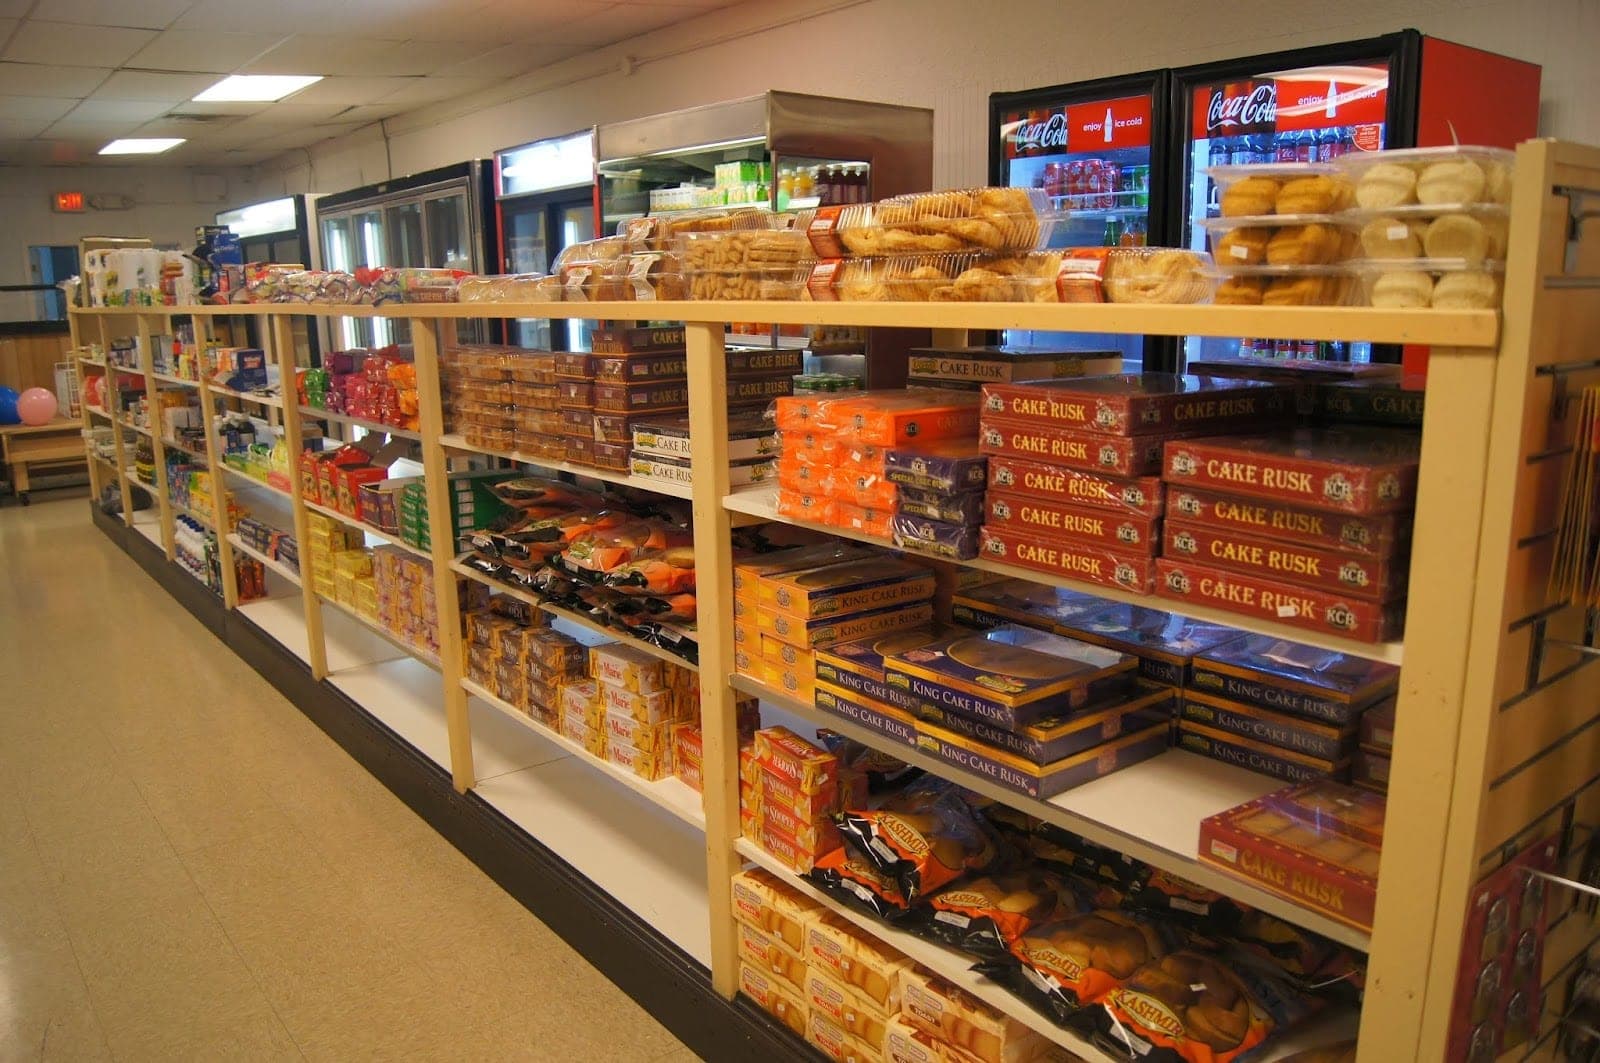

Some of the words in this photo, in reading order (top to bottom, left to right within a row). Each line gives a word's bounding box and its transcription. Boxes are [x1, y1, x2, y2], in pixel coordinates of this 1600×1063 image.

[1298, 95, 1323, 106] enjoy
[1083, 123, 1103, 133] enjoy
[1115, 120, 1125, 128] ice
[1127, 117, 1142, 126] cold
[652, 332, 679, 345] CAKE
[652, 362, 679, 375] CAKE
[749, 356, 772, 369] CAKE
[775, 354, 799, 367] RUSK
[940, 360, 969, 375] CAKE
[973, 363, 1003, 378] RUSK
[651, 391, 679, 404] CAKE
[739, 383, 763, 396] CAKE
[765, 381, 789, 394] RUSK
[1013, 398, 1048, 417] CAKE
[1051, 401, 1086, 421] RUSK
[1174, 402, 1215, 421] CAKE
[657, 437, 678, 451] CAKE
[1012, 434, 1048, 453] CAKE
[1052, 439, 1088, 460] RUSK
[1100, 450, 1119, 465] KCB
[653, 464, 674, 479] CAKE
[676, 467, 692, 483] RUS
[995, 470, 1013, 485] KCB
[1025, 472, 1065, 492] CAKE
[1069, 478, 1109, 499] RUSK
[1122, 489, 1144, 505] KCB
[1207, 459, 1257, 484] CAKE
[1263, 468, 1313, 493] RUSK
[1324, 479, 1351, 497] KCB
[992, 504, 1011, 519] KCB
[1021, 507, 1061, 528] CAKE
[1064, 514, 1104, 536] RUSK
[1117, 527, 1138, 542] KCB
[1178, 496, 1200, 512] KCB
[1215, 502, 1267, 526] CAKE
[1272, 511, 1323, 535] RUSK
[1017, 544, 1057, 565] CAKE
[1061, 553, 1101, 575] RUSK
[1115, 567, 1137, 582] KCB
[1173, 535, 1196, 551] KCB
[1211, 540, 1263, 565] CAKE
[1268, 551, 1321, 576] RUSK
[1339, 566, 1367, 584] KCB
[842, 596, 868, 608] KING
[871, 590, 897, 602] CAKE
[900, 584, 925, 596] RUSK
[1166, 573, 1190, 590] KCB
[1200, 579, 1255, 605] CAKE
[1261, 592, 1318, 619] RUSK
[1326, 608, 1355, 626] KCB
[840, 624, 866, 637] KING
[839, 672, 861, 689] KING
[864, 681, 887, 698] CAKE
[913, 681, 940, 700] KING
[942, 691, 971, 710] CAKE
[975, 701, 1004, 722] RUSK
[1228, 680, 1261, 698] KING
[1264, 689, 1299, 707] CAKE
[1303, 699, 1339, 719] RUSK
[837, 699, 858, 718] KING
[860, 710, 882, 728] CAKE
[885, 719, 909, 739] RUSK
[946, 713, 973, 733] KING
[976, 724, 1003, 744] CAKE
[1007, 735, 1037, 755] RUSK
[1218, 713, 1250, 732] KING
[1253, 723, 1288, 742] CAKE
[1292, 734, 1328, 754] RUSK
[941, 743, 967, 765] KING
[970, 755, 997, 777] CAKE
[1000, 768, 1029, 789] RUSK
[1214, 743, 1246, 763] KING
[1249, 754, 1283, 773] CAKE
[1287, 765, 1314, 782] RUS
[880, 813, 928, 855] KASHMIR
[1240, 850, 1287, 885] CAKE
[1291, 872, 1344, 910] RUSK
[1024, 949, 1081, 979] KASHMIR
[1117, 990, 1182, 1036] KASHMIR
